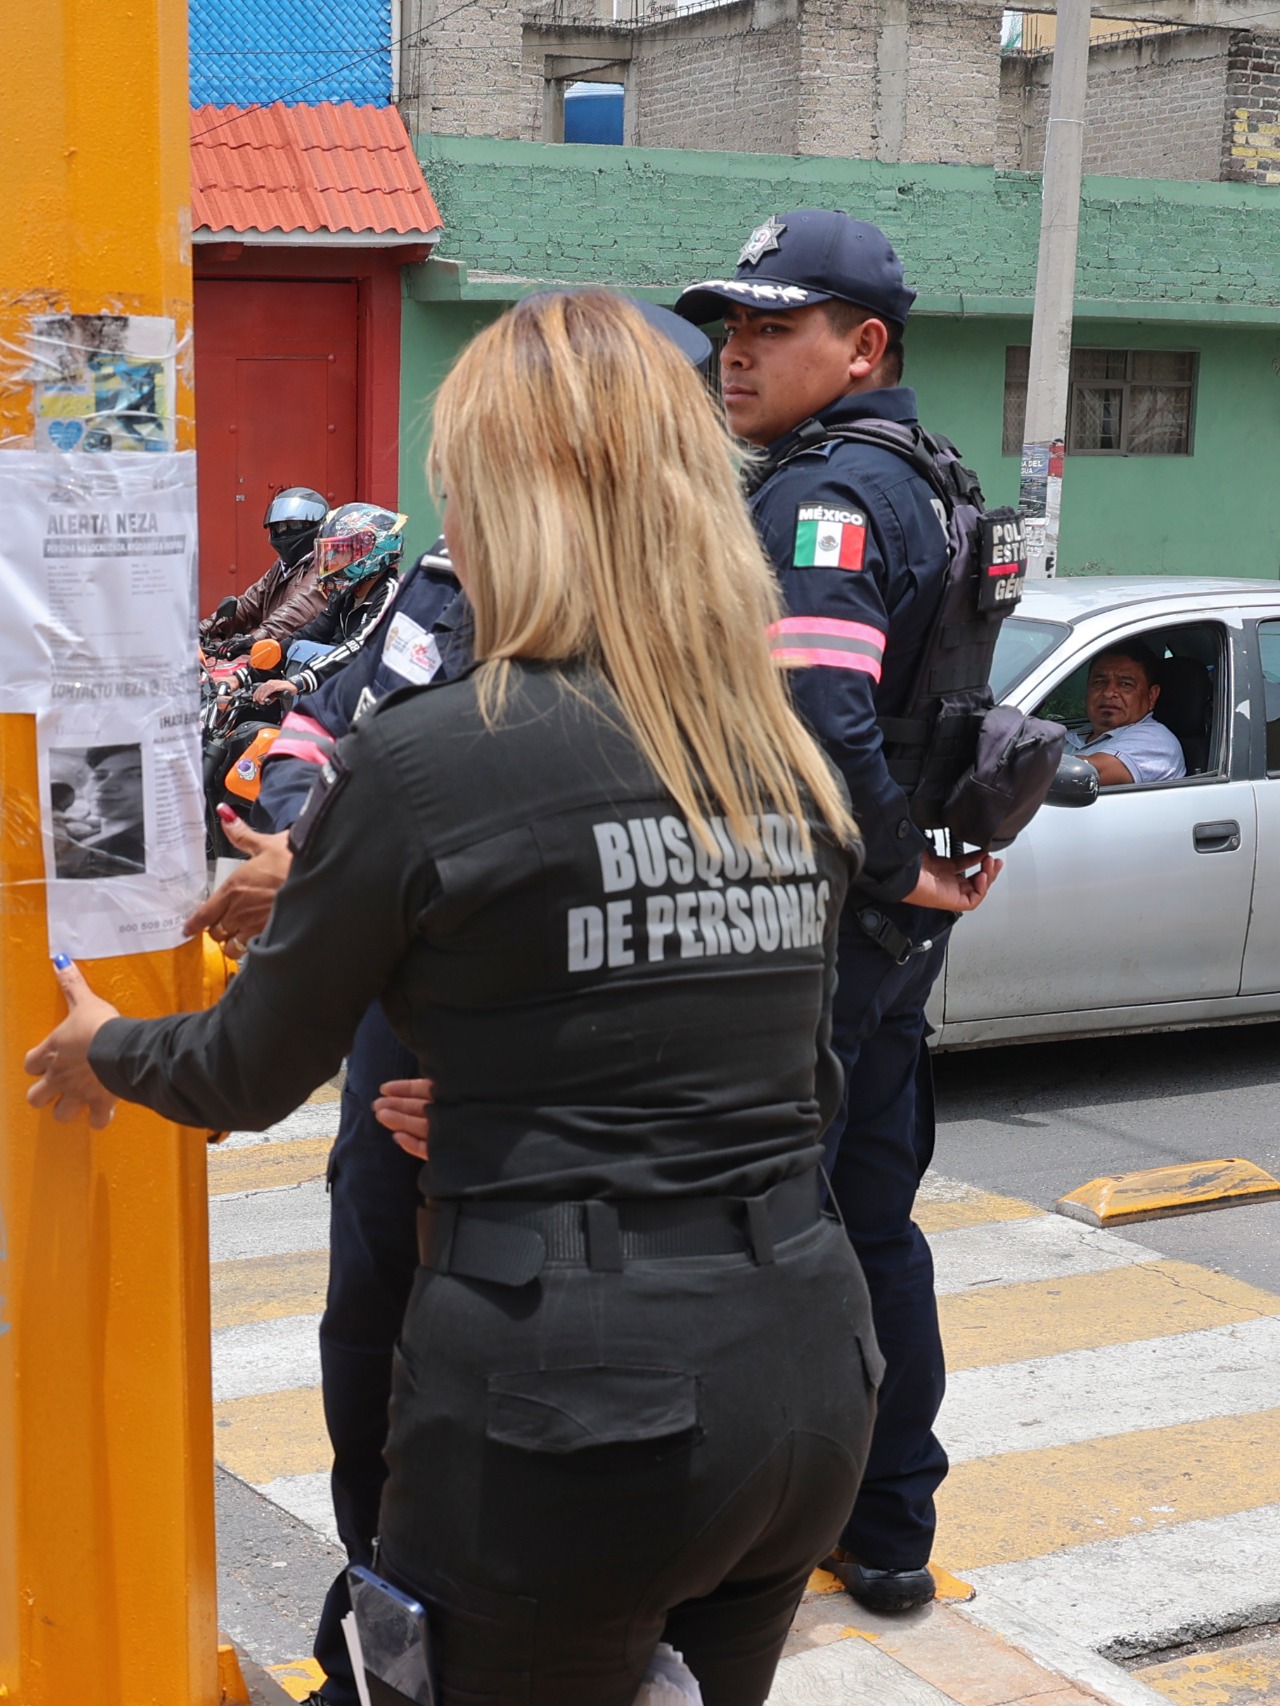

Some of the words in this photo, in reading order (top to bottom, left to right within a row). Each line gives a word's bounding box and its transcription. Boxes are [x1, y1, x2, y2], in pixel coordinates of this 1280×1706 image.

[47, 514, 112, 535] ALERTA
[116, 513, 159, 534] NEZA
[798, 506, 863, 526] MÉXICO
[567, 900, 635, 972] DE
[645, 880, 831, 962] PERSONAS
